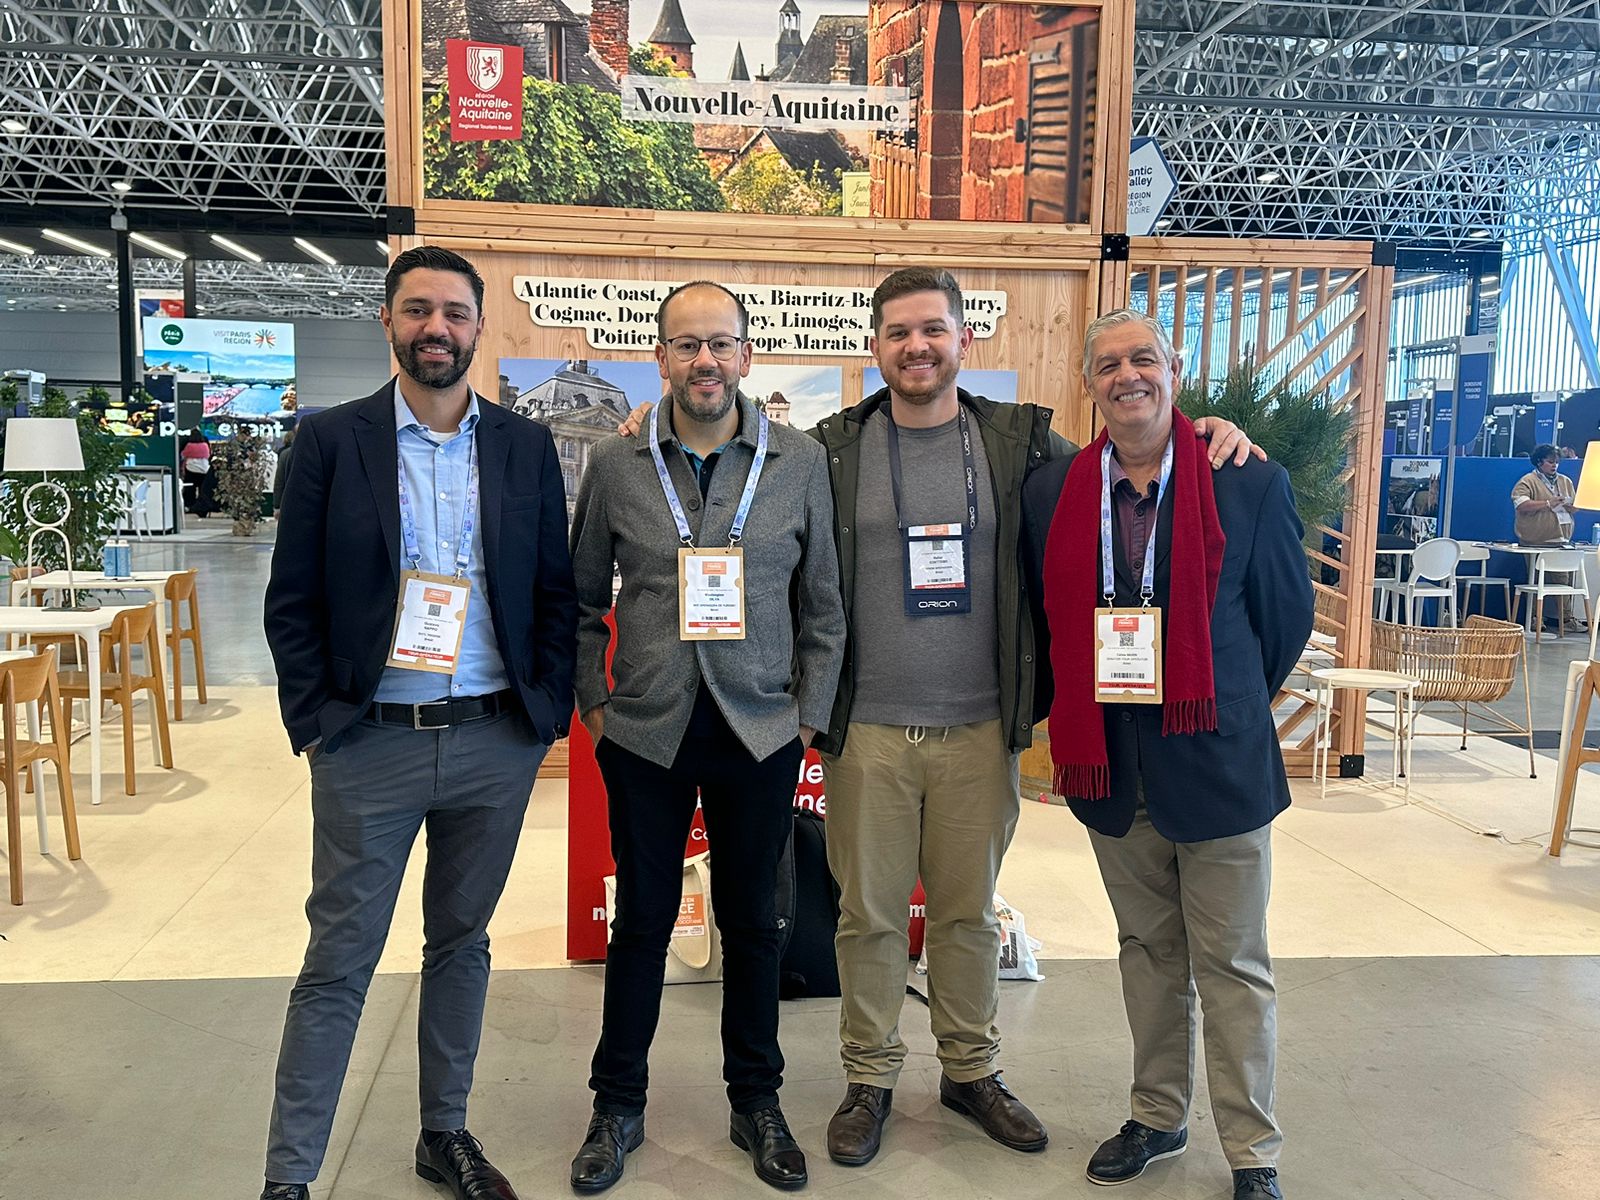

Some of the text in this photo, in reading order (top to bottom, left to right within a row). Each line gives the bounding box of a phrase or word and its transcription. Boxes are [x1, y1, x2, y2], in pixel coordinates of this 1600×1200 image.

[458, 97, 513, 109] Nouvelle-
[634, 87, 900, 124] Nouvelle-Aquitaine
[459, 108, 513, 121] Aquitaine
[1128, 165, 1153, 177] antic
[1128, 176, 1153, 187] alley
[519, 281, 598, 300] Atlantic
[770, 289, 874, 308] Biarritz-Ba
[963, 296, 1001, 314] ntry,
[534, 303, 612, 325] Cognac,
[781, 311, 863, 332] Limoges,
[593, 327, 660, 345] Poitier
[918, 600, 957, 609] ORION
[679, 903, 695, 914] CE
